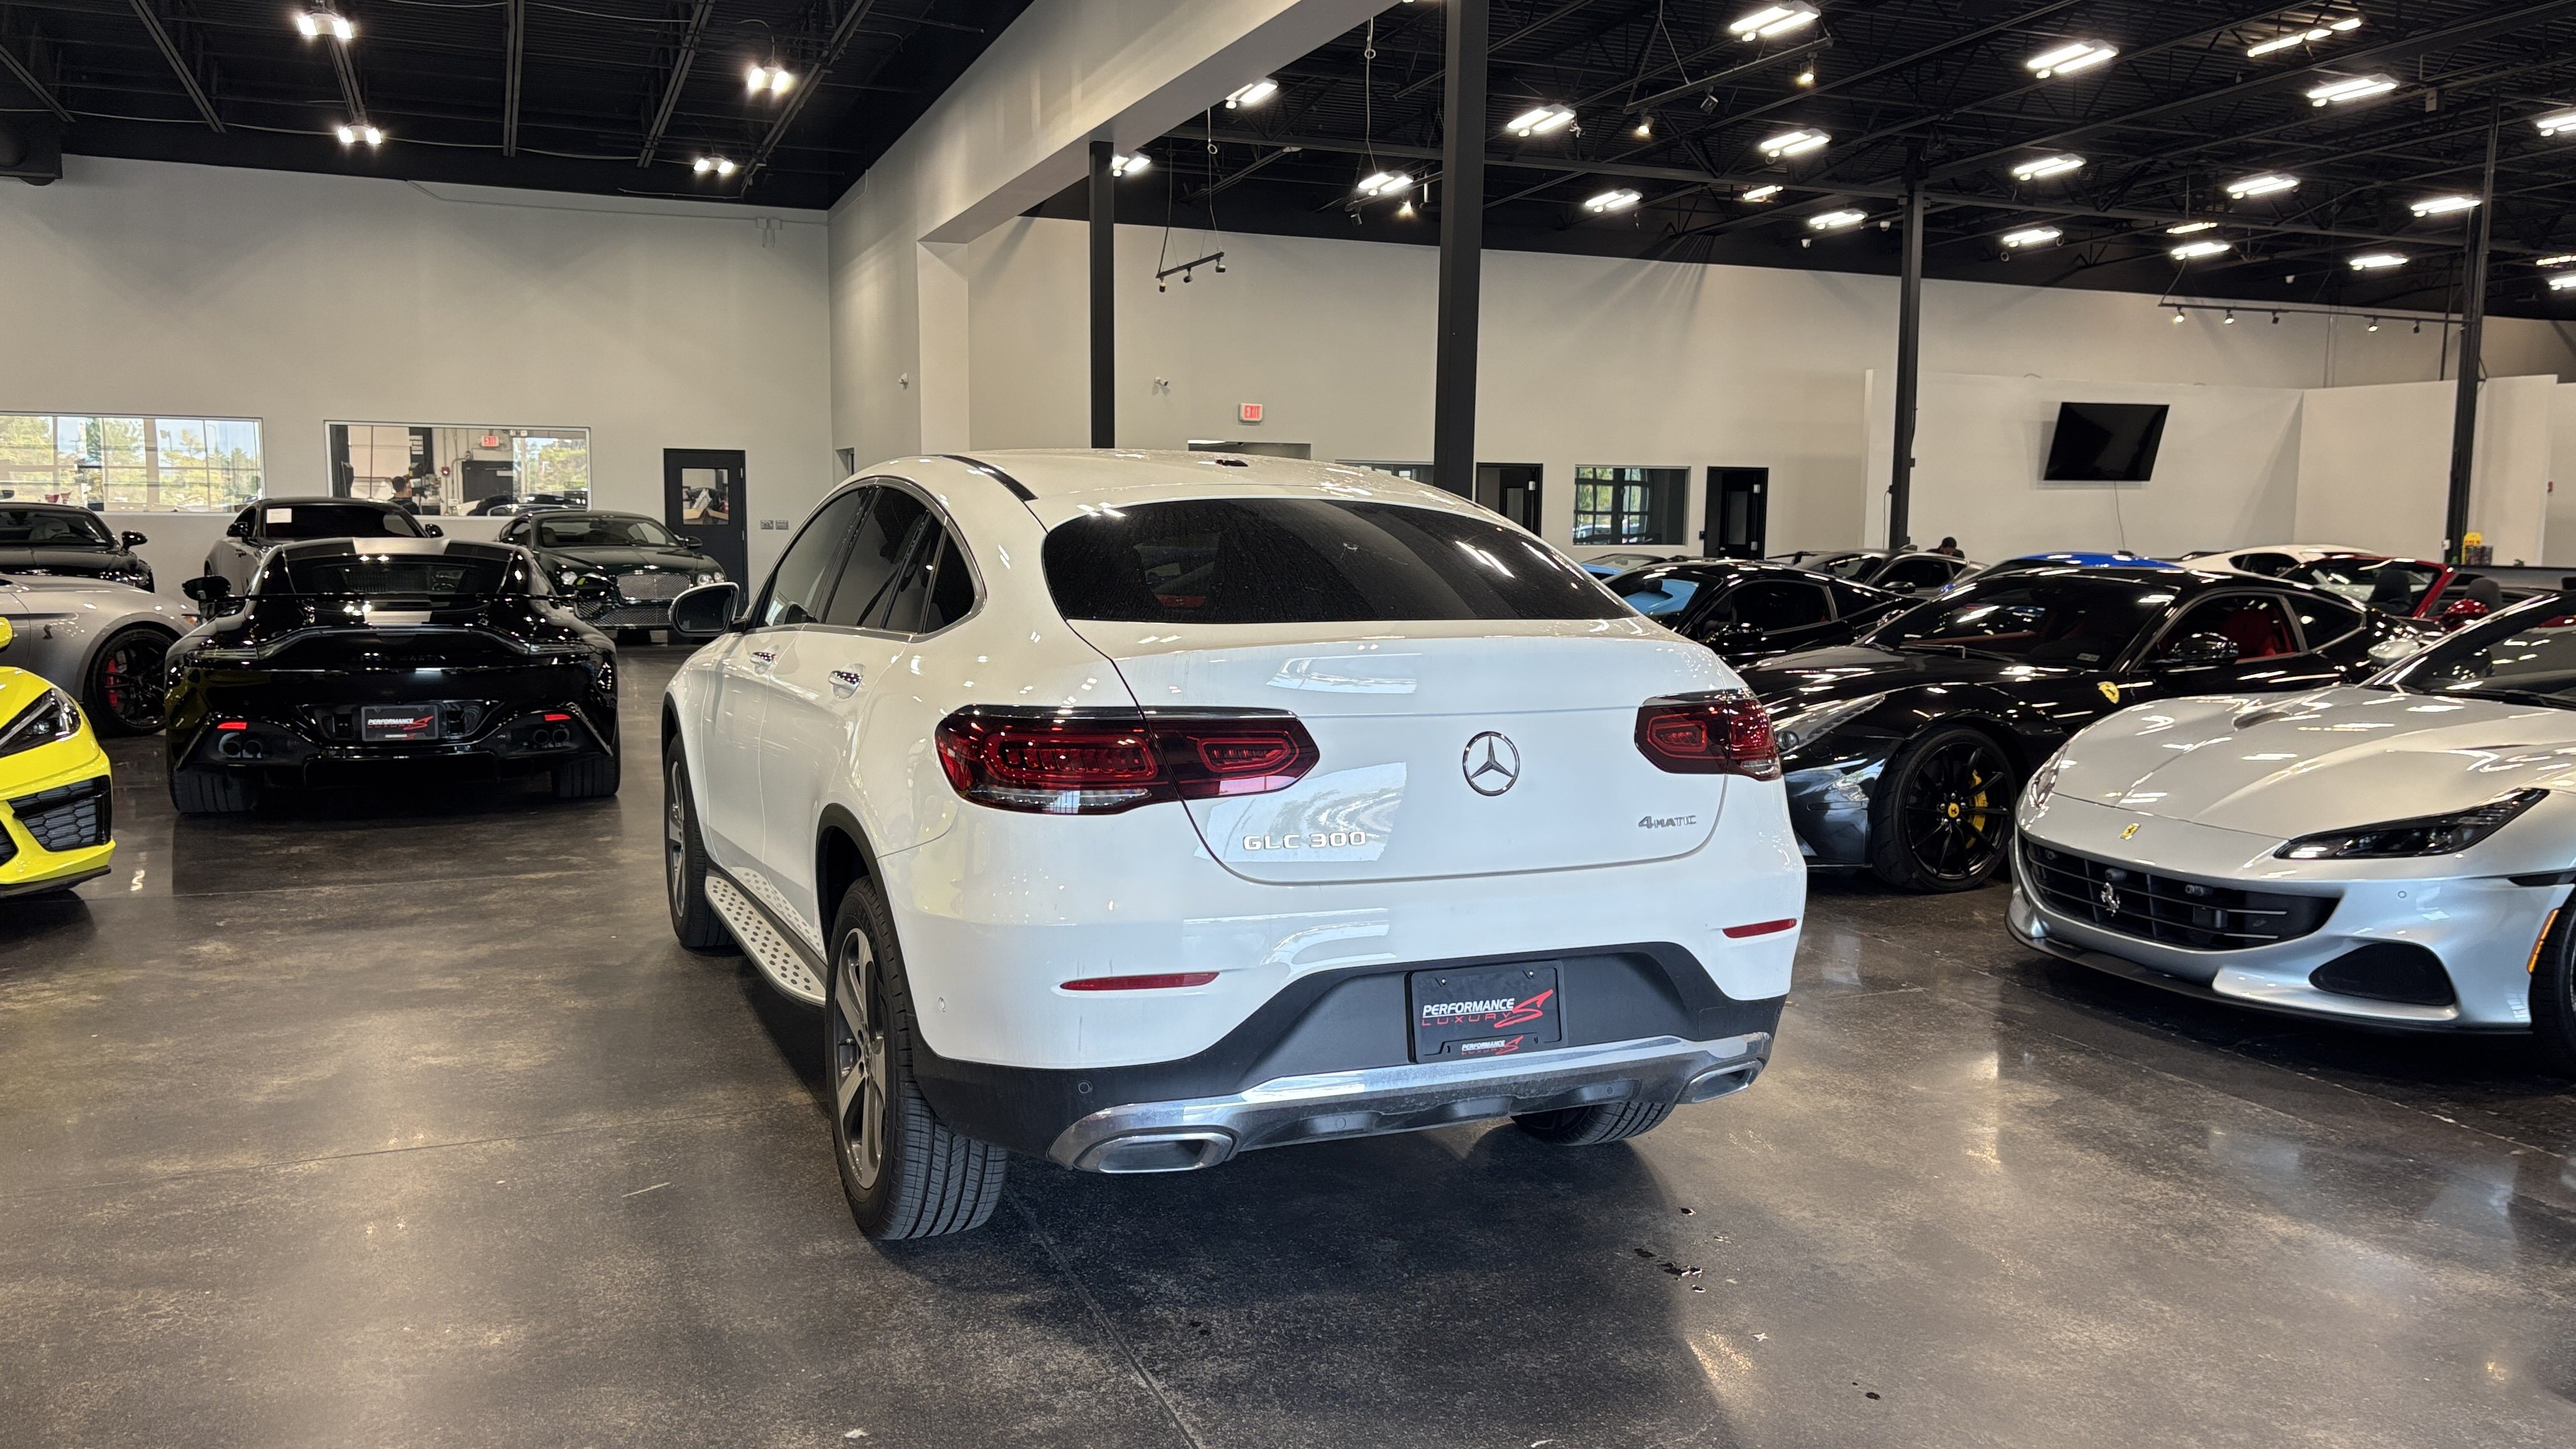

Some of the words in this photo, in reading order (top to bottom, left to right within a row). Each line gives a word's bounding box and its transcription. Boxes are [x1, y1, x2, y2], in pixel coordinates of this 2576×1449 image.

[1245, 406, 1260, 418] EXIT
[1638, 815, 1697, 829] 4MATIC
[1243, 834, 1300, 850] GLC
[1310, 831, 1366, 848] 300
[1423, 997, 1515, 1016] PERFORMANCE
[1462, 1040, 1506, 1051] PERFORMANCE
